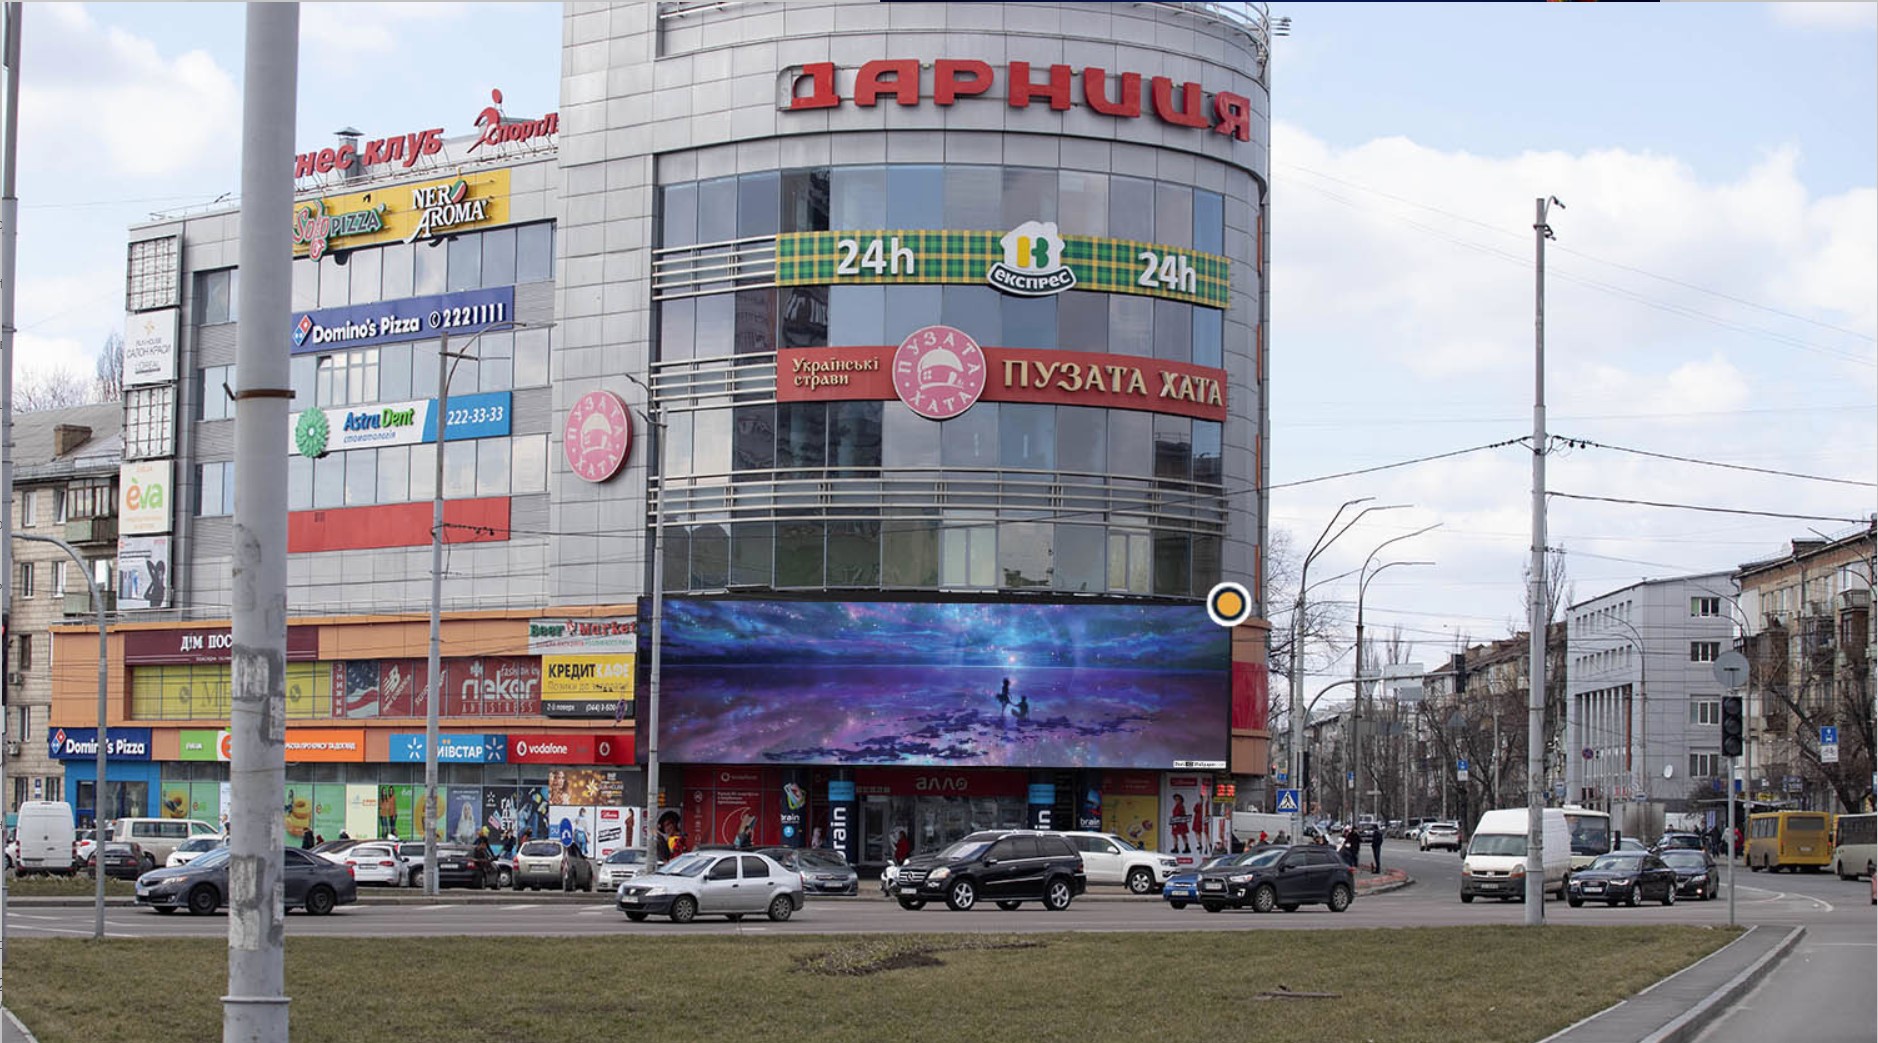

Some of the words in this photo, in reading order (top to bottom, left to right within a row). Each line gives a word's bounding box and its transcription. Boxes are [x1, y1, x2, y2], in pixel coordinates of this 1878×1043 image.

[777, 58, 1251, 142] ДАРНИЦЯ
[483, 112, 558, 146] СпортЛ
[294, 143, 354, 179] нес
[330, 209, 382, 236] PIZZA
[403, 201, 486, 244] AROMA
[836, 237, 915, 275] 24h
[995, 268, 1071, 290] експрес
[1137, 251, 1197, 293] 24h
[312, 318, 377, 343] Domino's
[380, 315, 420, 336] Pizza
[442, 302, 505, 328] 2221111
[791, 356, 879, 376] Українські
[899, 330, 981, 374] ПУЗАТА
[794, 371, 849, 391] страви
[1003, 359, 1148, 396] ПУЗАТА
[1160, 371, 1224, 407] ХАТА
[447, 406, 503, 426] 222-33-33
[909, 391, 972, 415] ХАТА
[208, 633, 232, 649] ПОС
[530, 624, 565, 638] Beer
[579, 620, 636, 637] Market
[461, 668, 540, 700] rieker
[66, 739, 114, 754] Domin's
[116, 738, 146, 755] Pizza
[437, 738, 484, 759] ИЇВСТАР
[529, 744, 568, 754] vodafone
[830, 806, 847, 860] rain
